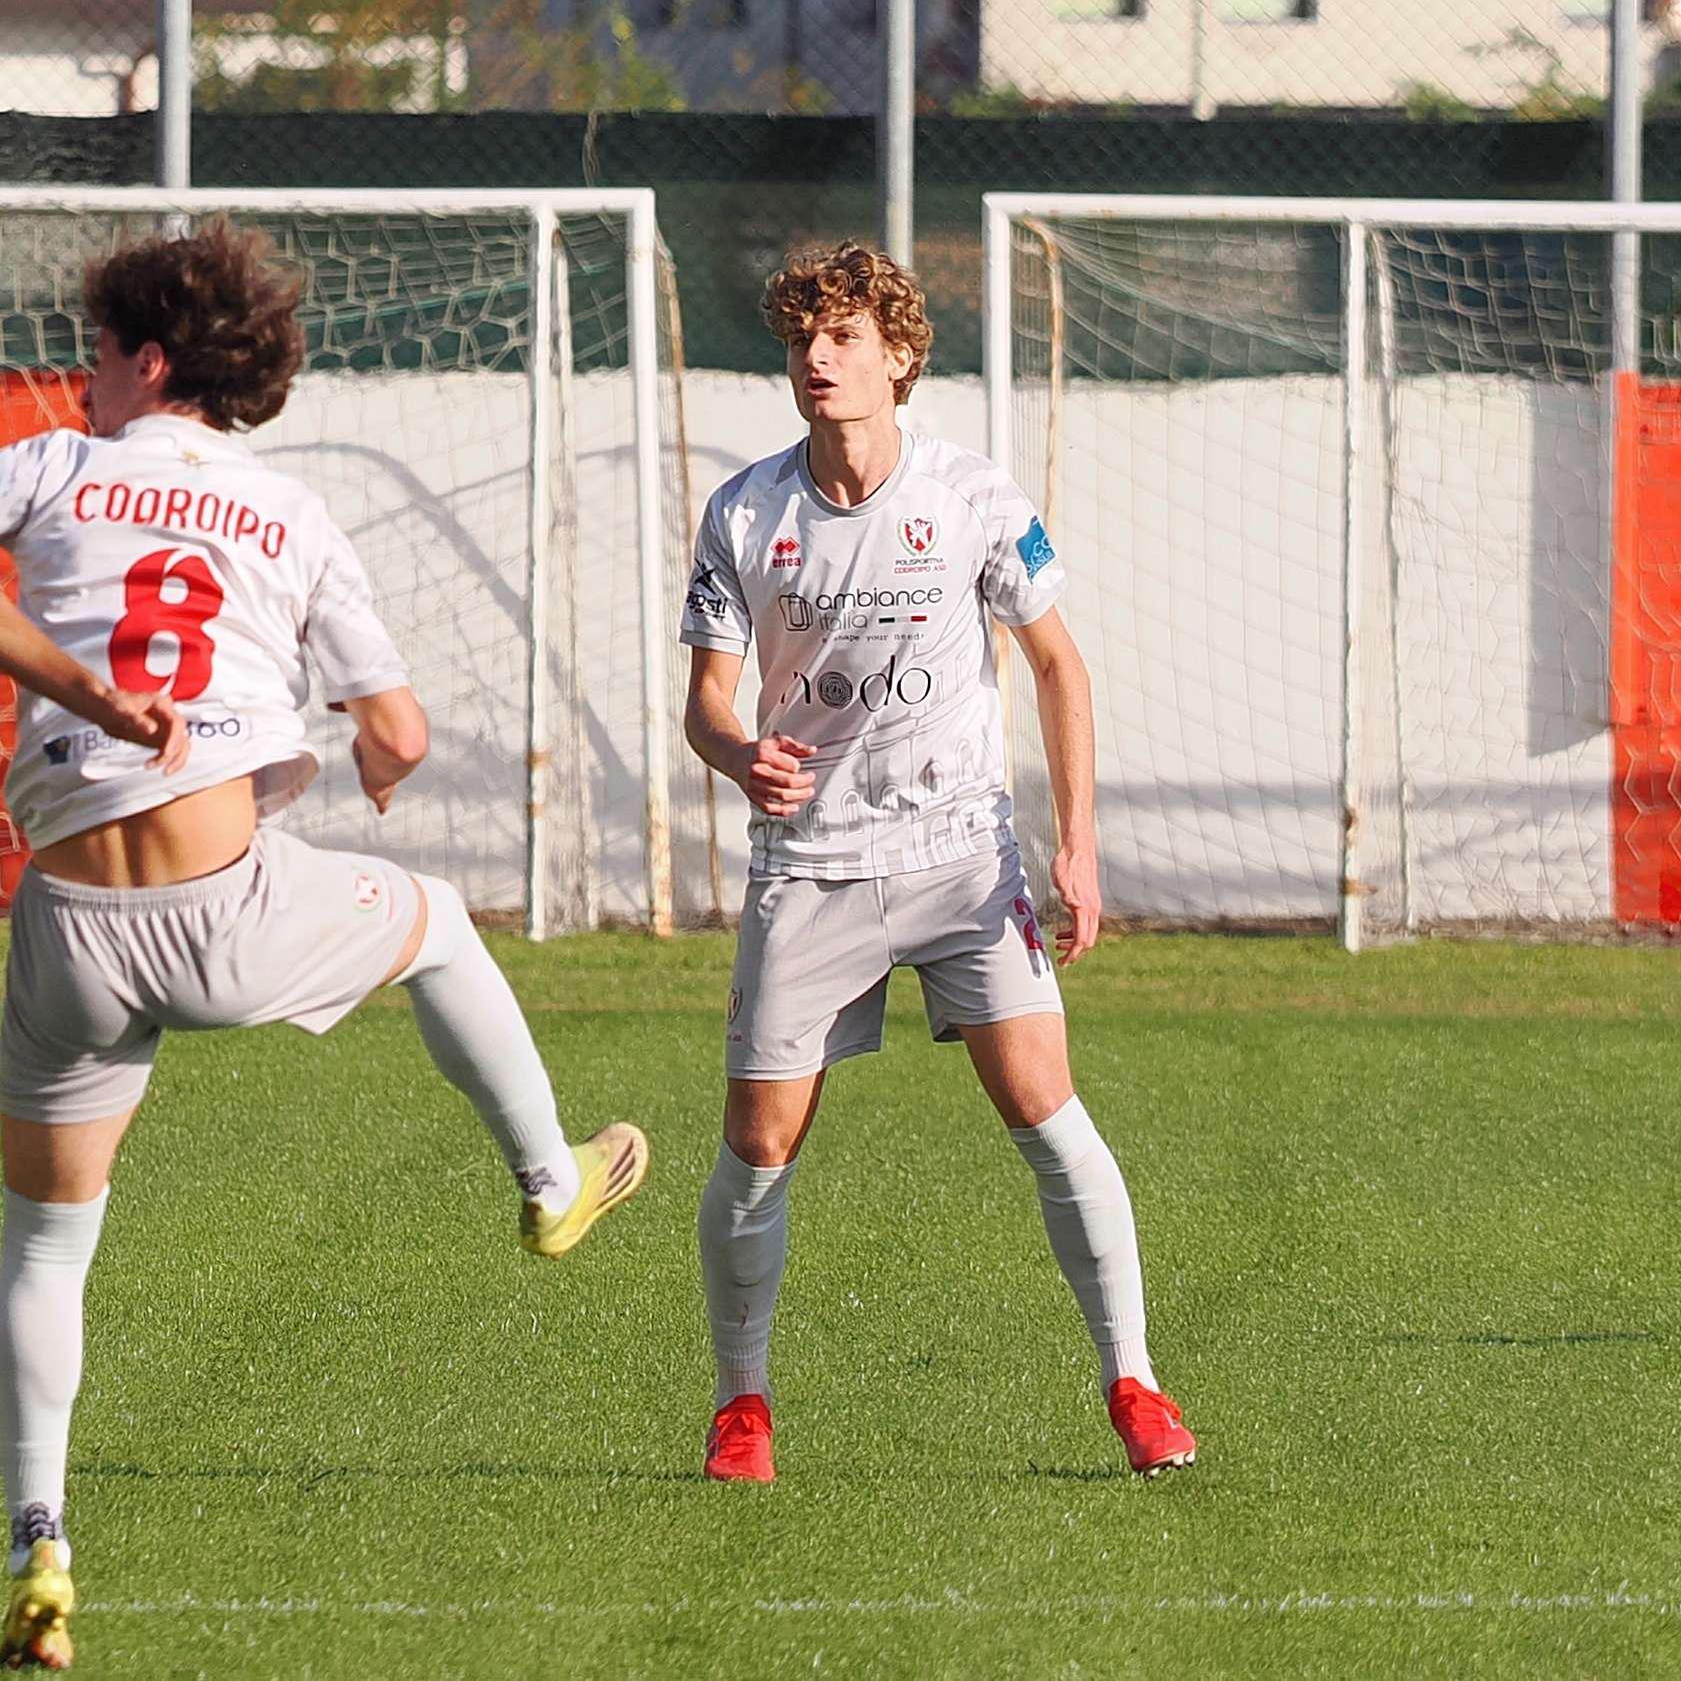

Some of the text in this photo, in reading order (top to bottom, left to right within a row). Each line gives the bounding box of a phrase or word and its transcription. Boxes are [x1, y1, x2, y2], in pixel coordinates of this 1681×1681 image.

[73, 482, 287, 560] CODROIPO
[109, 547, 225, 702] 8
[815, 587, 944, 611] ambiance
